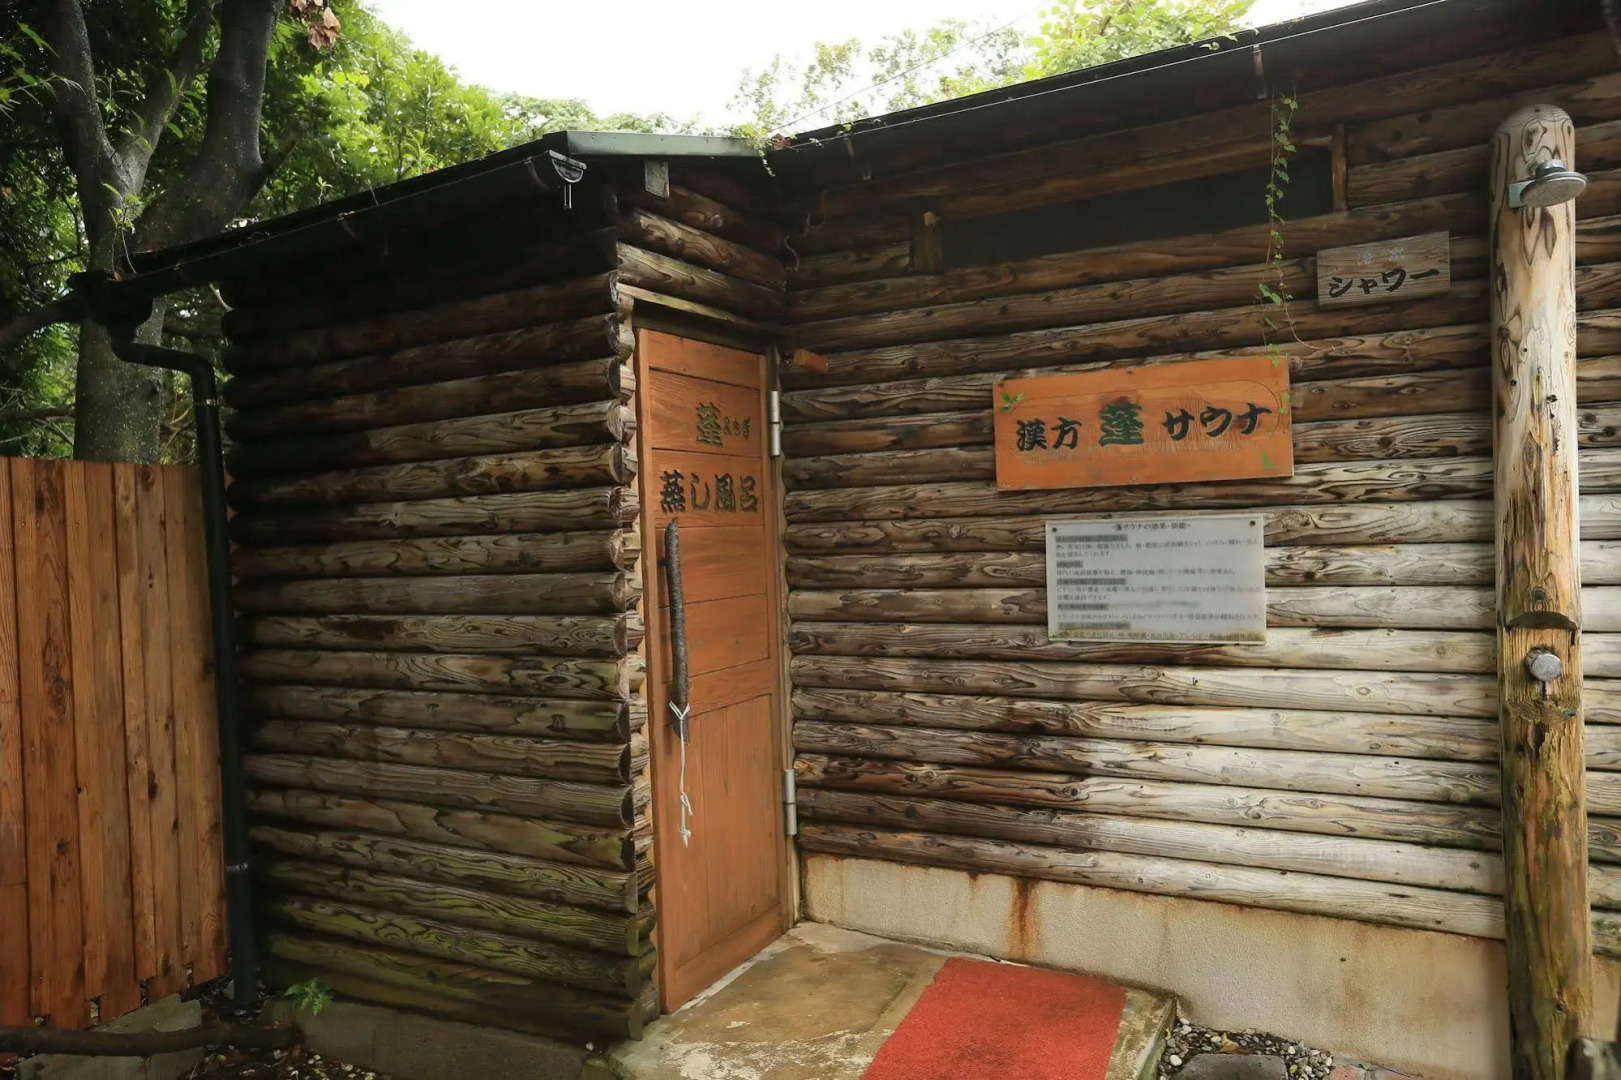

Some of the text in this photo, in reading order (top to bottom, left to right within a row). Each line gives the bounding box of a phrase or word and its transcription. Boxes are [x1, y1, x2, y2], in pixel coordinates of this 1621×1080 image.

[1329, 267, 1440, 298] シャワー
[1016, 417, 1082, 451] 漢方
[1161, 402, 1272, 441] サウナ
[660, 469, 758, 513] 蒸し風呂
